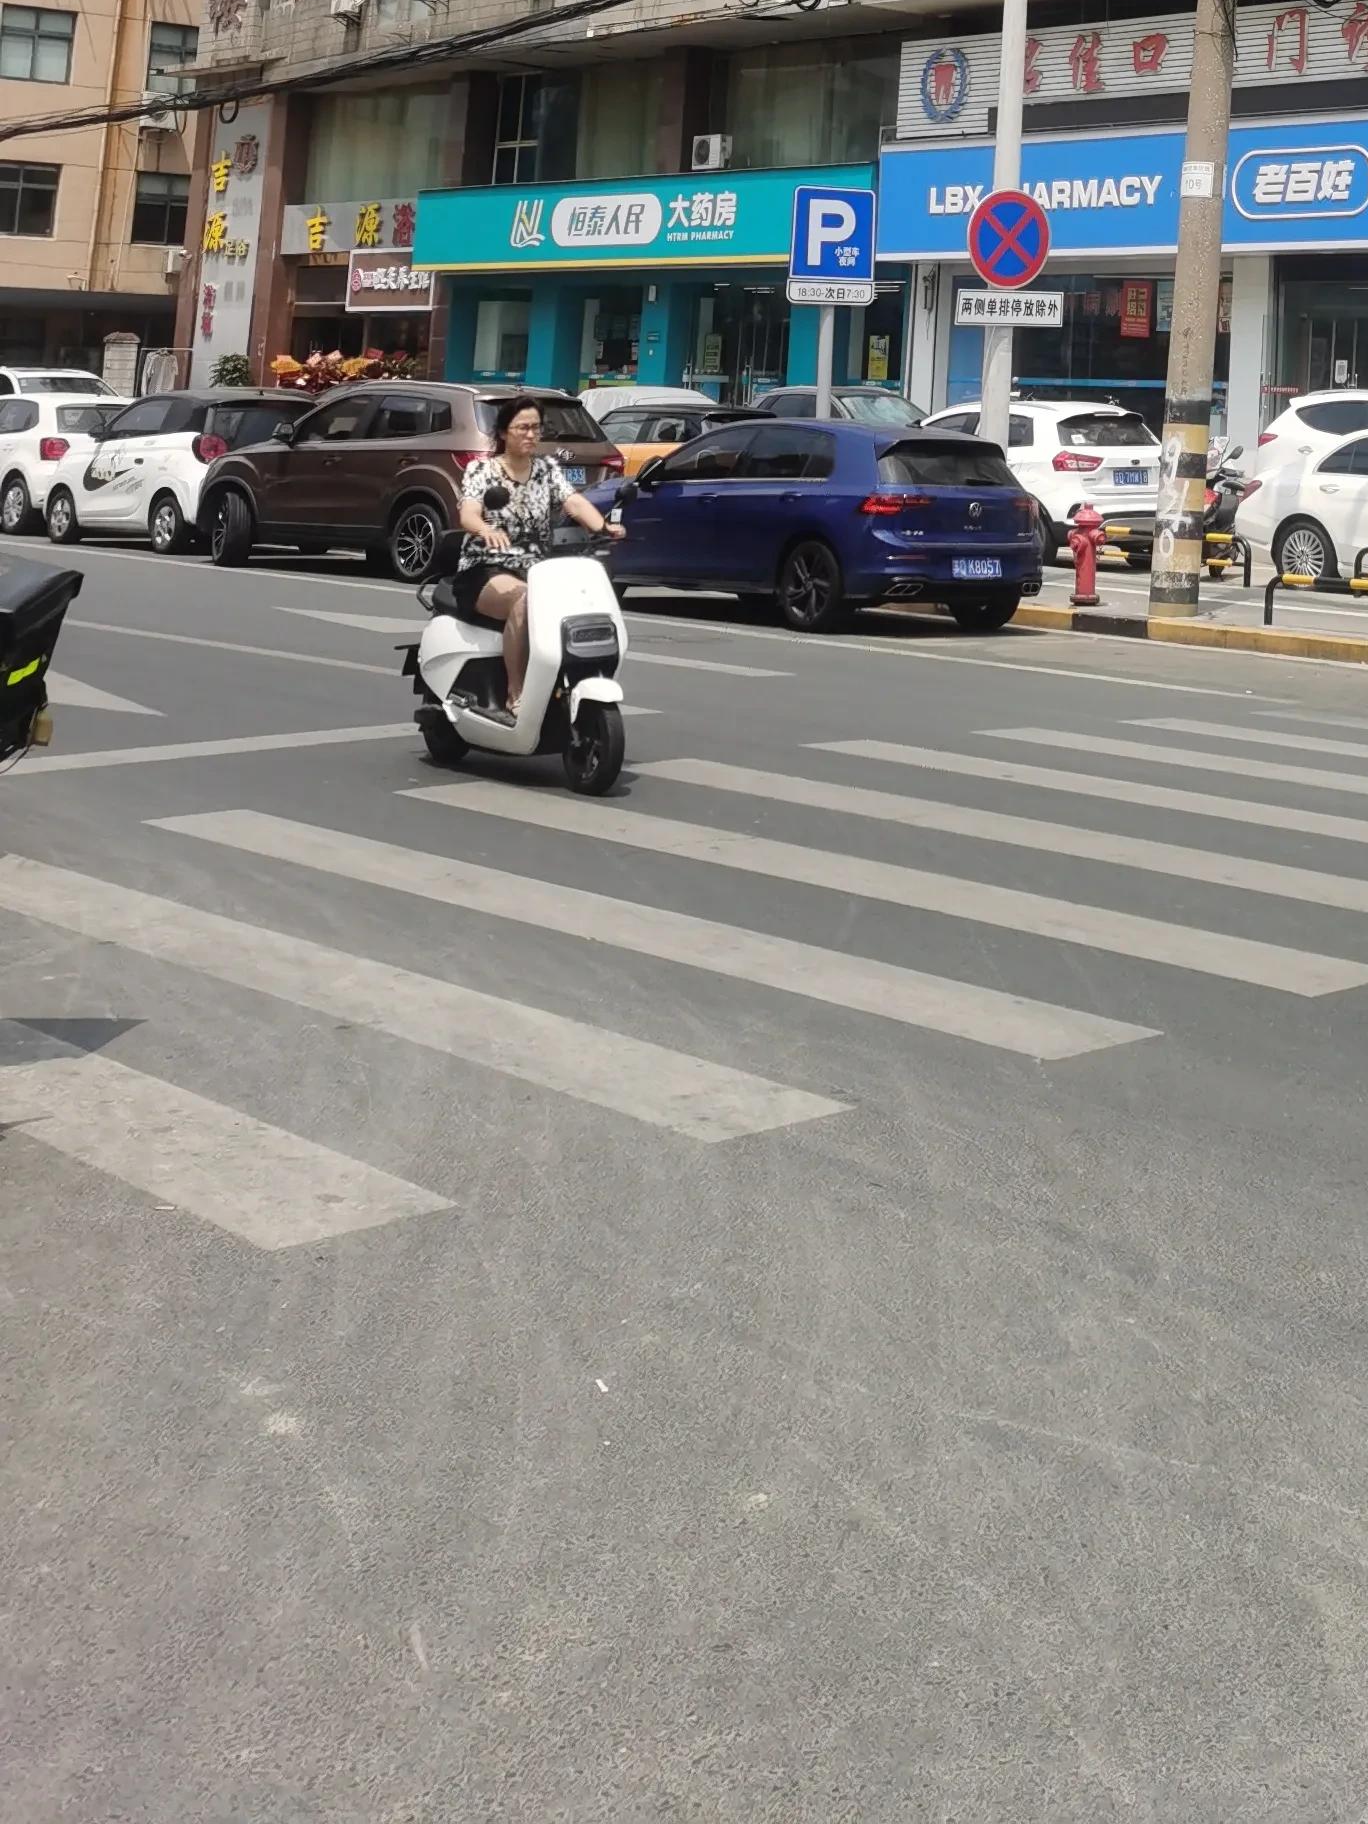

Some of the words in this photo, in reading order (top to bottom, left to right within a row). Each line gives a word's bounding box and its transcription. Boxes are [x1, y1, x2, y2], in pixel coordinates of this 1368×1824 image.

[1252, 159, 1355, 204] 老百姓
[567, 203, 646, 238] 恒泰人民
[666, 190, 738, 229] 大药房
[928, 184, 984, 215] LBX
[690, 230, 735, 242] PHARMACY
[806, 198, 857, 266] P
[833, 246, 861, 258] 小型车
[960, 296, 1060, 319] 两侧单排停放除外
